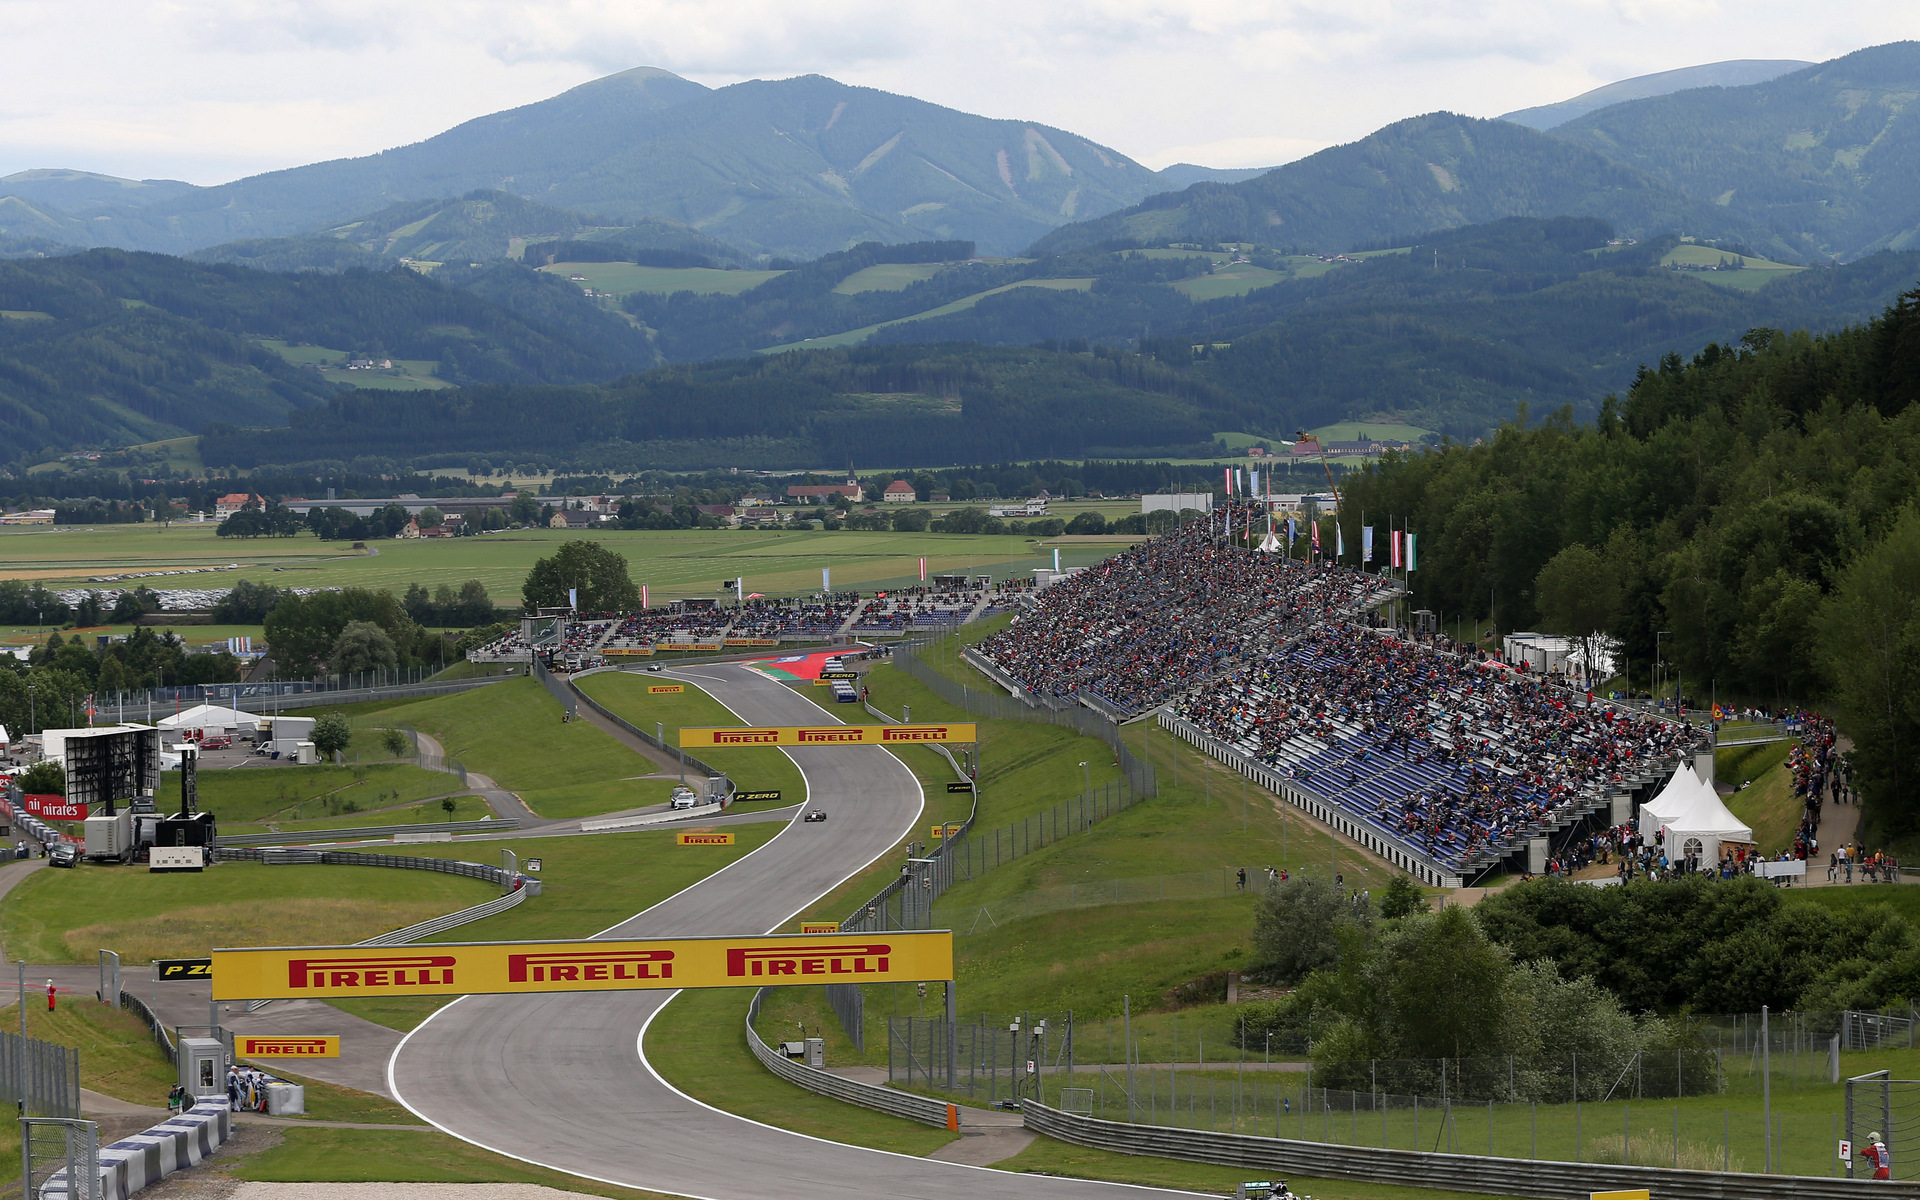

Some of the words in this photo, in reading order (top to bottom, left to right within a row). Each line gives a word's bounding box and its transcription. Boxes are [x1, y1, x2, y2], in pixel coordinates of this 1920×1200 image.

[714, 731, 778, 743] PIRELLI
[798, 730, 863, 741] PIRELLI
[883, 728, 947, 740] PIRELLI
[684, 835, 727, 843] PIRELLI
[509, 950, 675, 982] PIRELLI
[727, 944, 891, 976] PIRELLI
[165, 966, 183, 975] P
[289, 956, 456, 988] PIRELLI
[246, 1040, 327, 1054] PIRELLI
[1842, 1144, 1848, 1155] F
